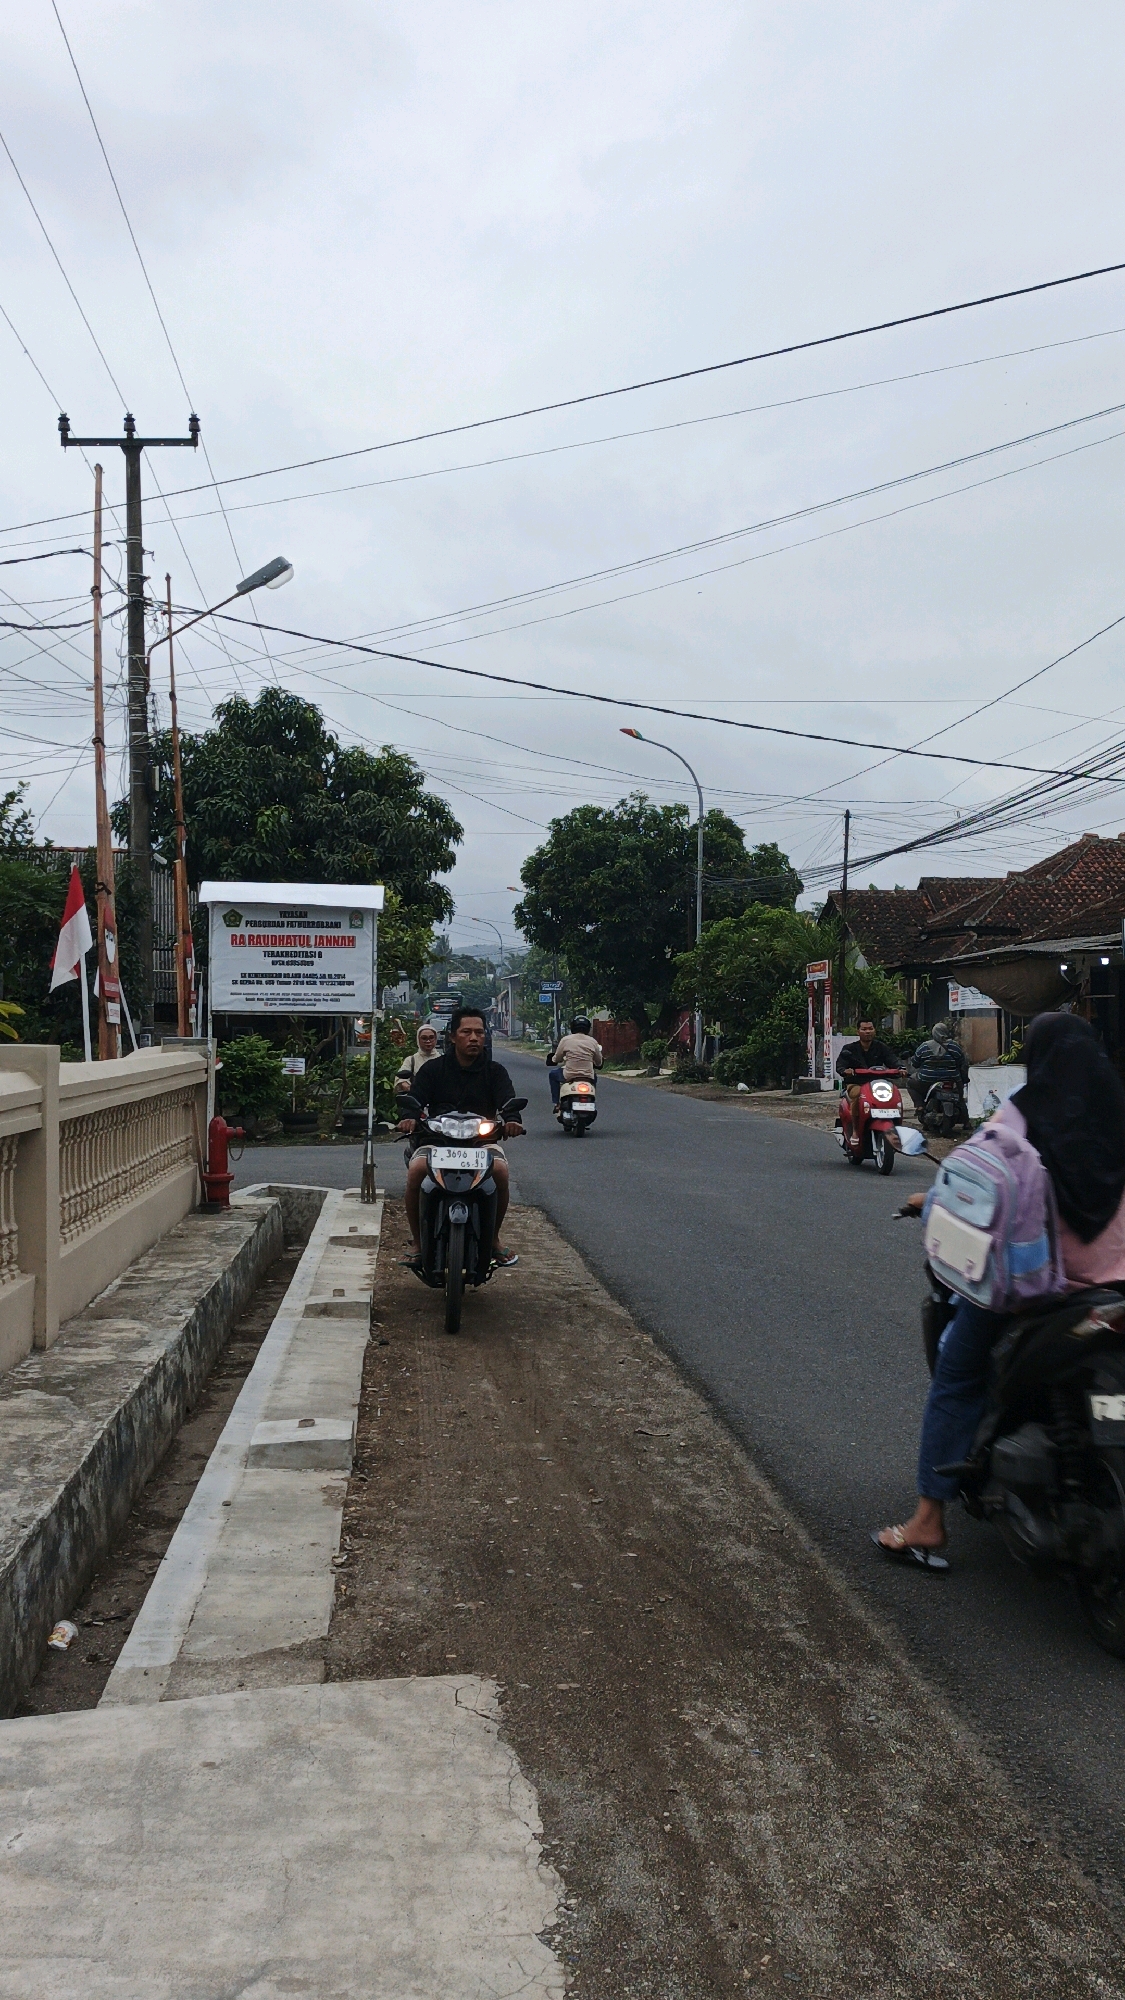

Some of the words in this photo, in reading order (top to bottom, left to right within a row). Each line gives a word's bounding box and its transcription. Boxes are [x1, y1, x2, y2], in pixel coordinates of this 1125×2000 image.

[230, 933, 247, 947] RA
[247, 934, 311, 948] RAUDHATUL
[314, 935, 357, 948] JANNAH
[262, 950, 317, 959] TERAKREDITASI
